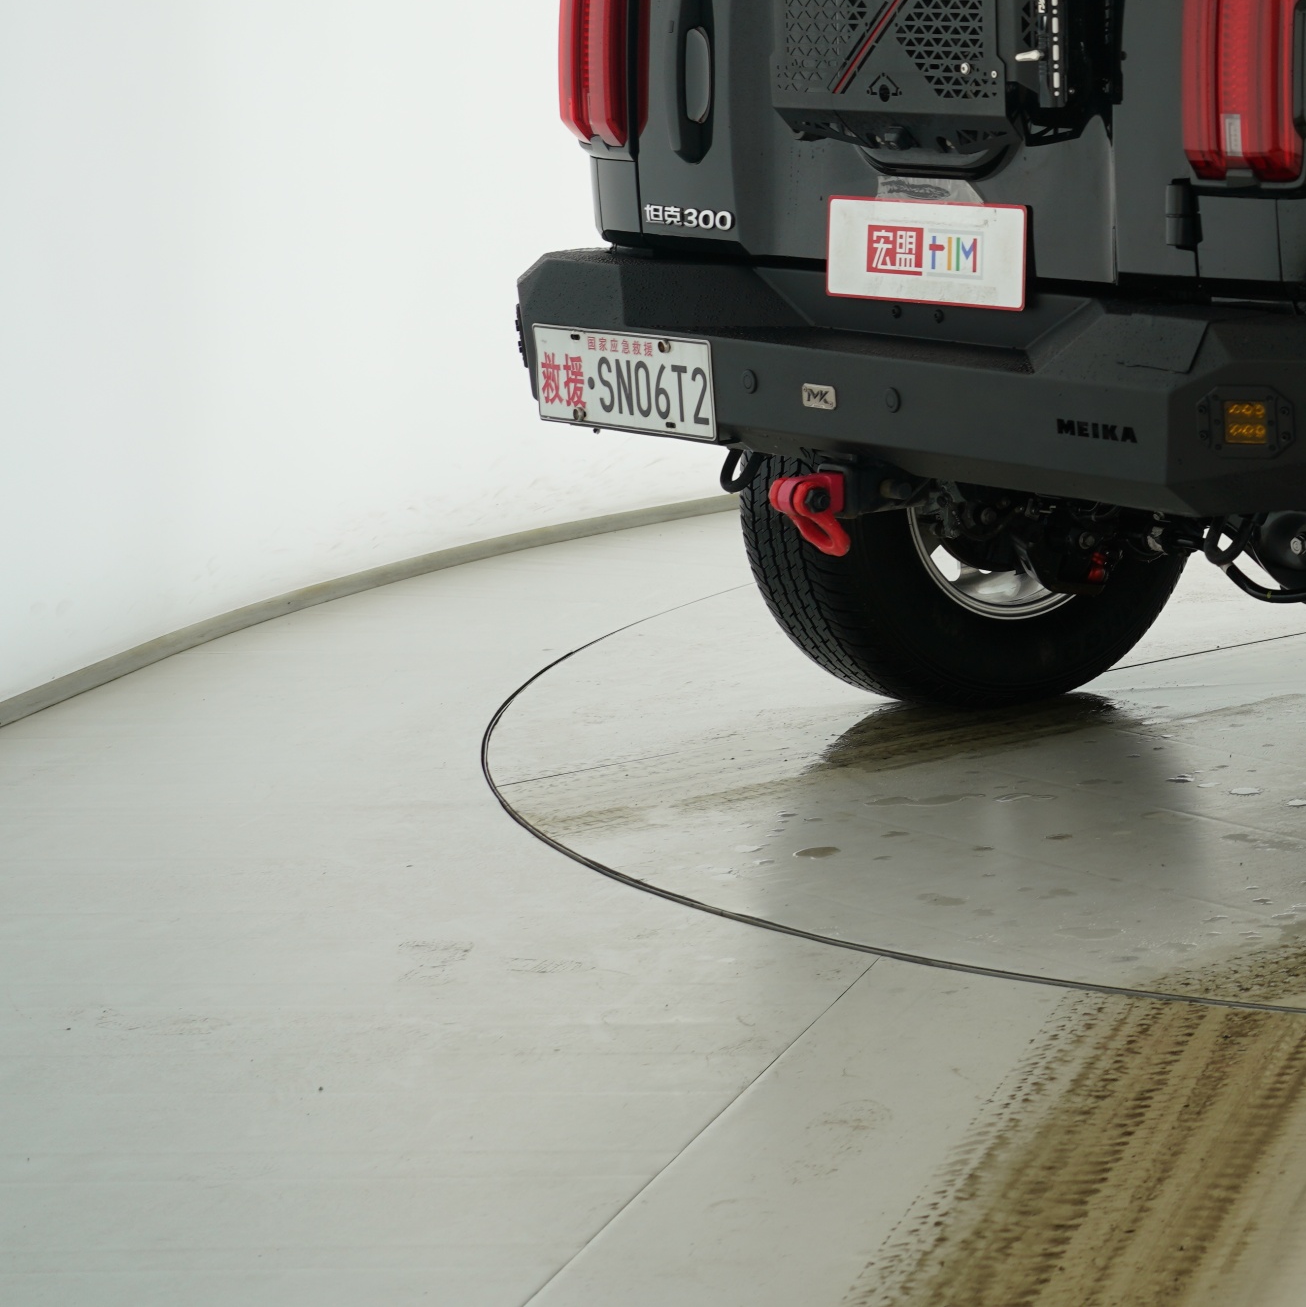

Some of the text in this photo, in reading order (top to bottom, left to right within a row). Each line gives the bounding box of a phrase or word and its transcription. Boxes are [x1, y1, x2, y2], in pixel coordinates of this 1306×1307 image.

[644, 204, 732, 231] 坦克300
[872, 229, 920, 272] 宏盟
[587, 336, 653, 357] 国家应急救援
[1056, 418, 1138, 443] MEIKA
